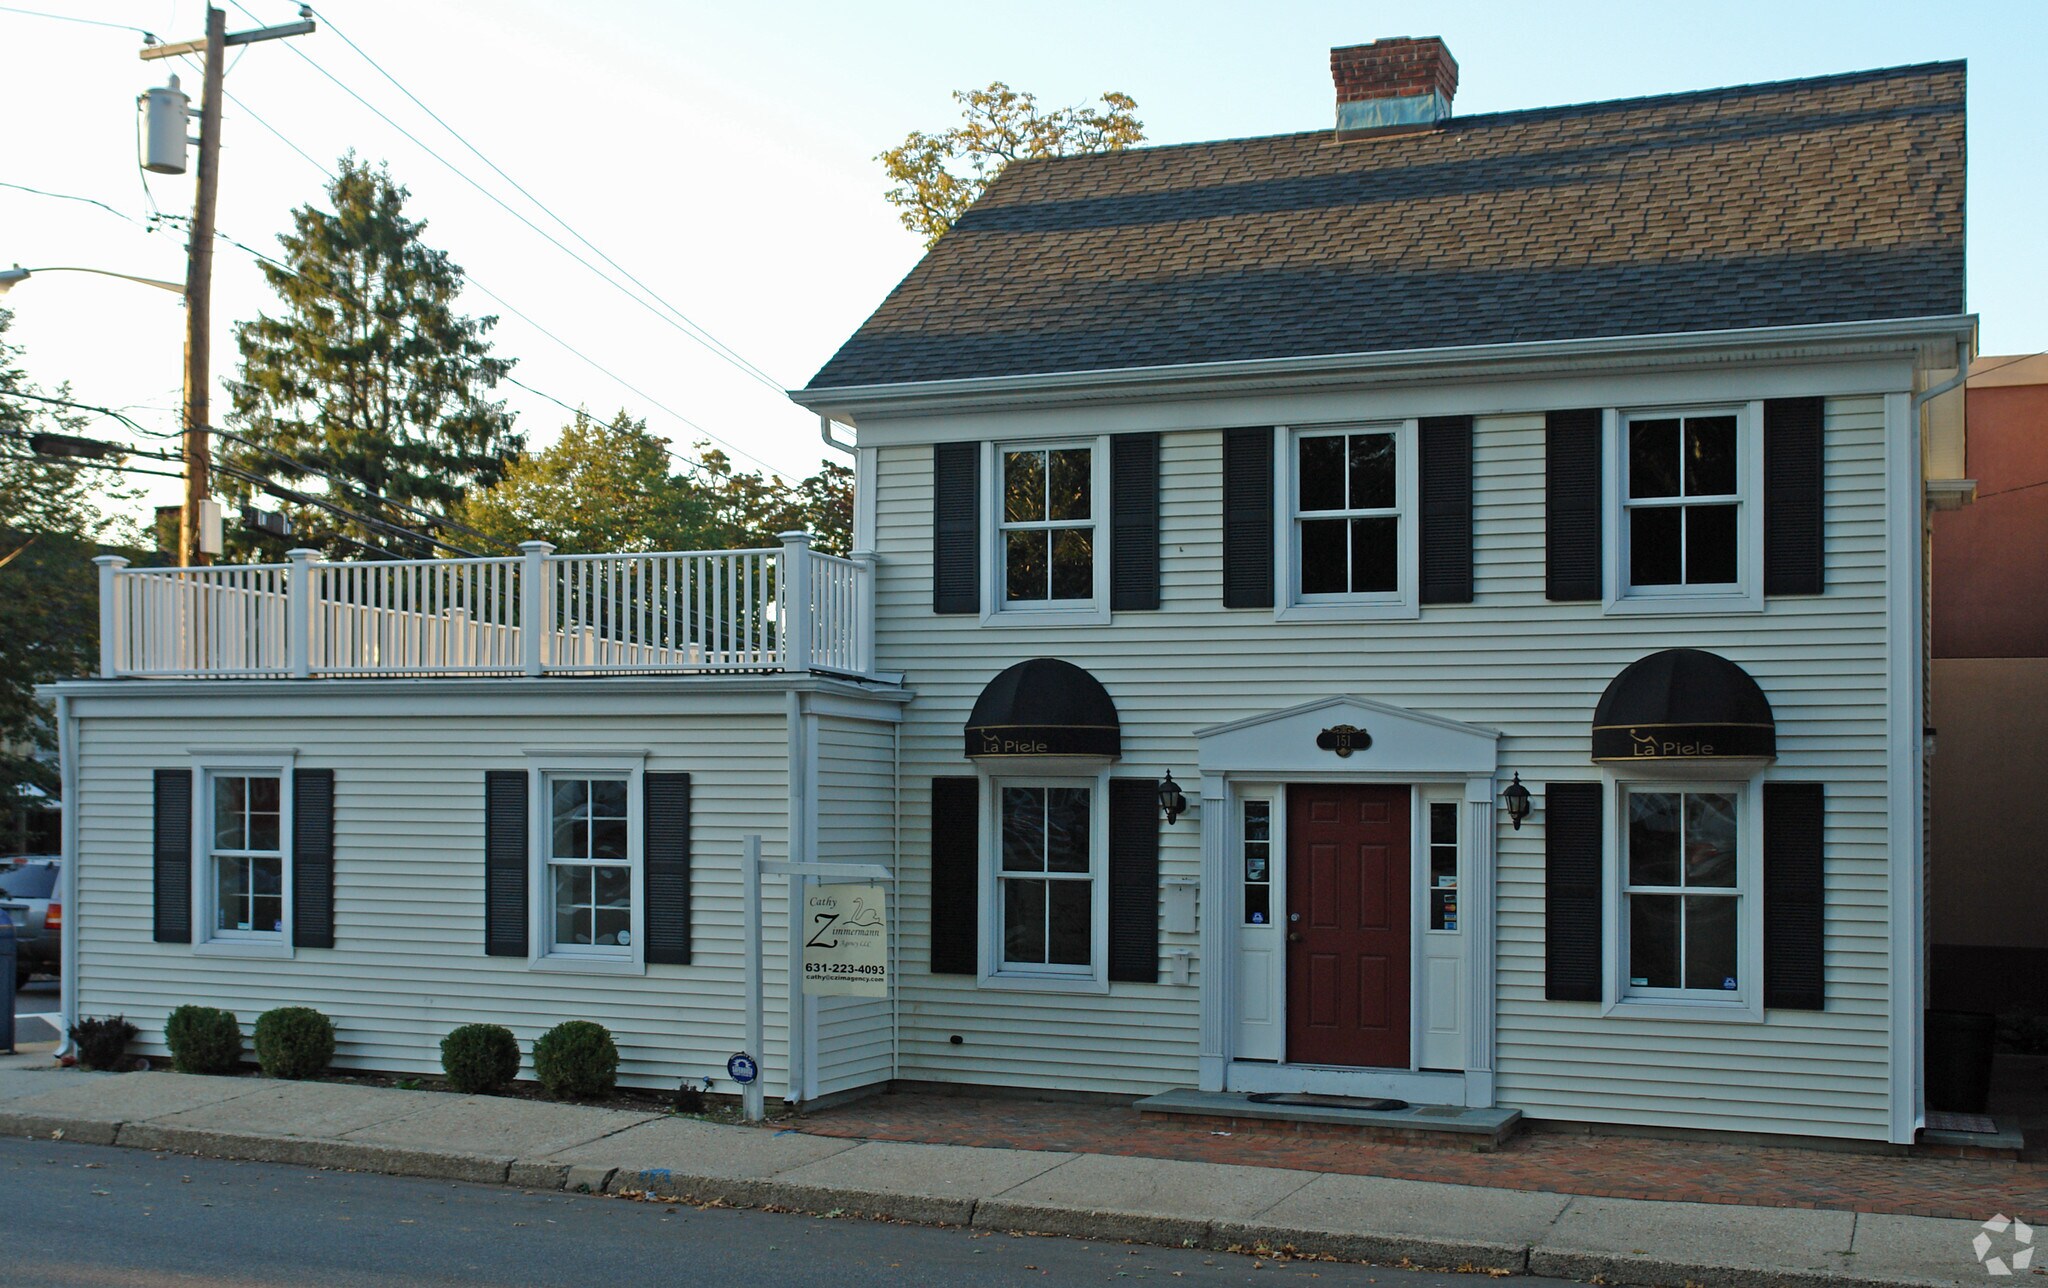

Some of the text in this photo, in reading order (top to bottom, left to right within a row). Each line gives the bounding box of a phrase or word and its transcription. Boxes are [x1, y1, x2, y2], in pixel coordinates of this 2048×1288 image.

[983, 739, 1048, 753] La Piele
[1336, 735, 1351, 747] 151
[1633, 741, 1714, 756] La Piele
[809, 896, 838, 909] Cathy
[805, 962, 885, 975] 631-223-4093
[806, 974, 884, 983] cathy@czimagency.com
